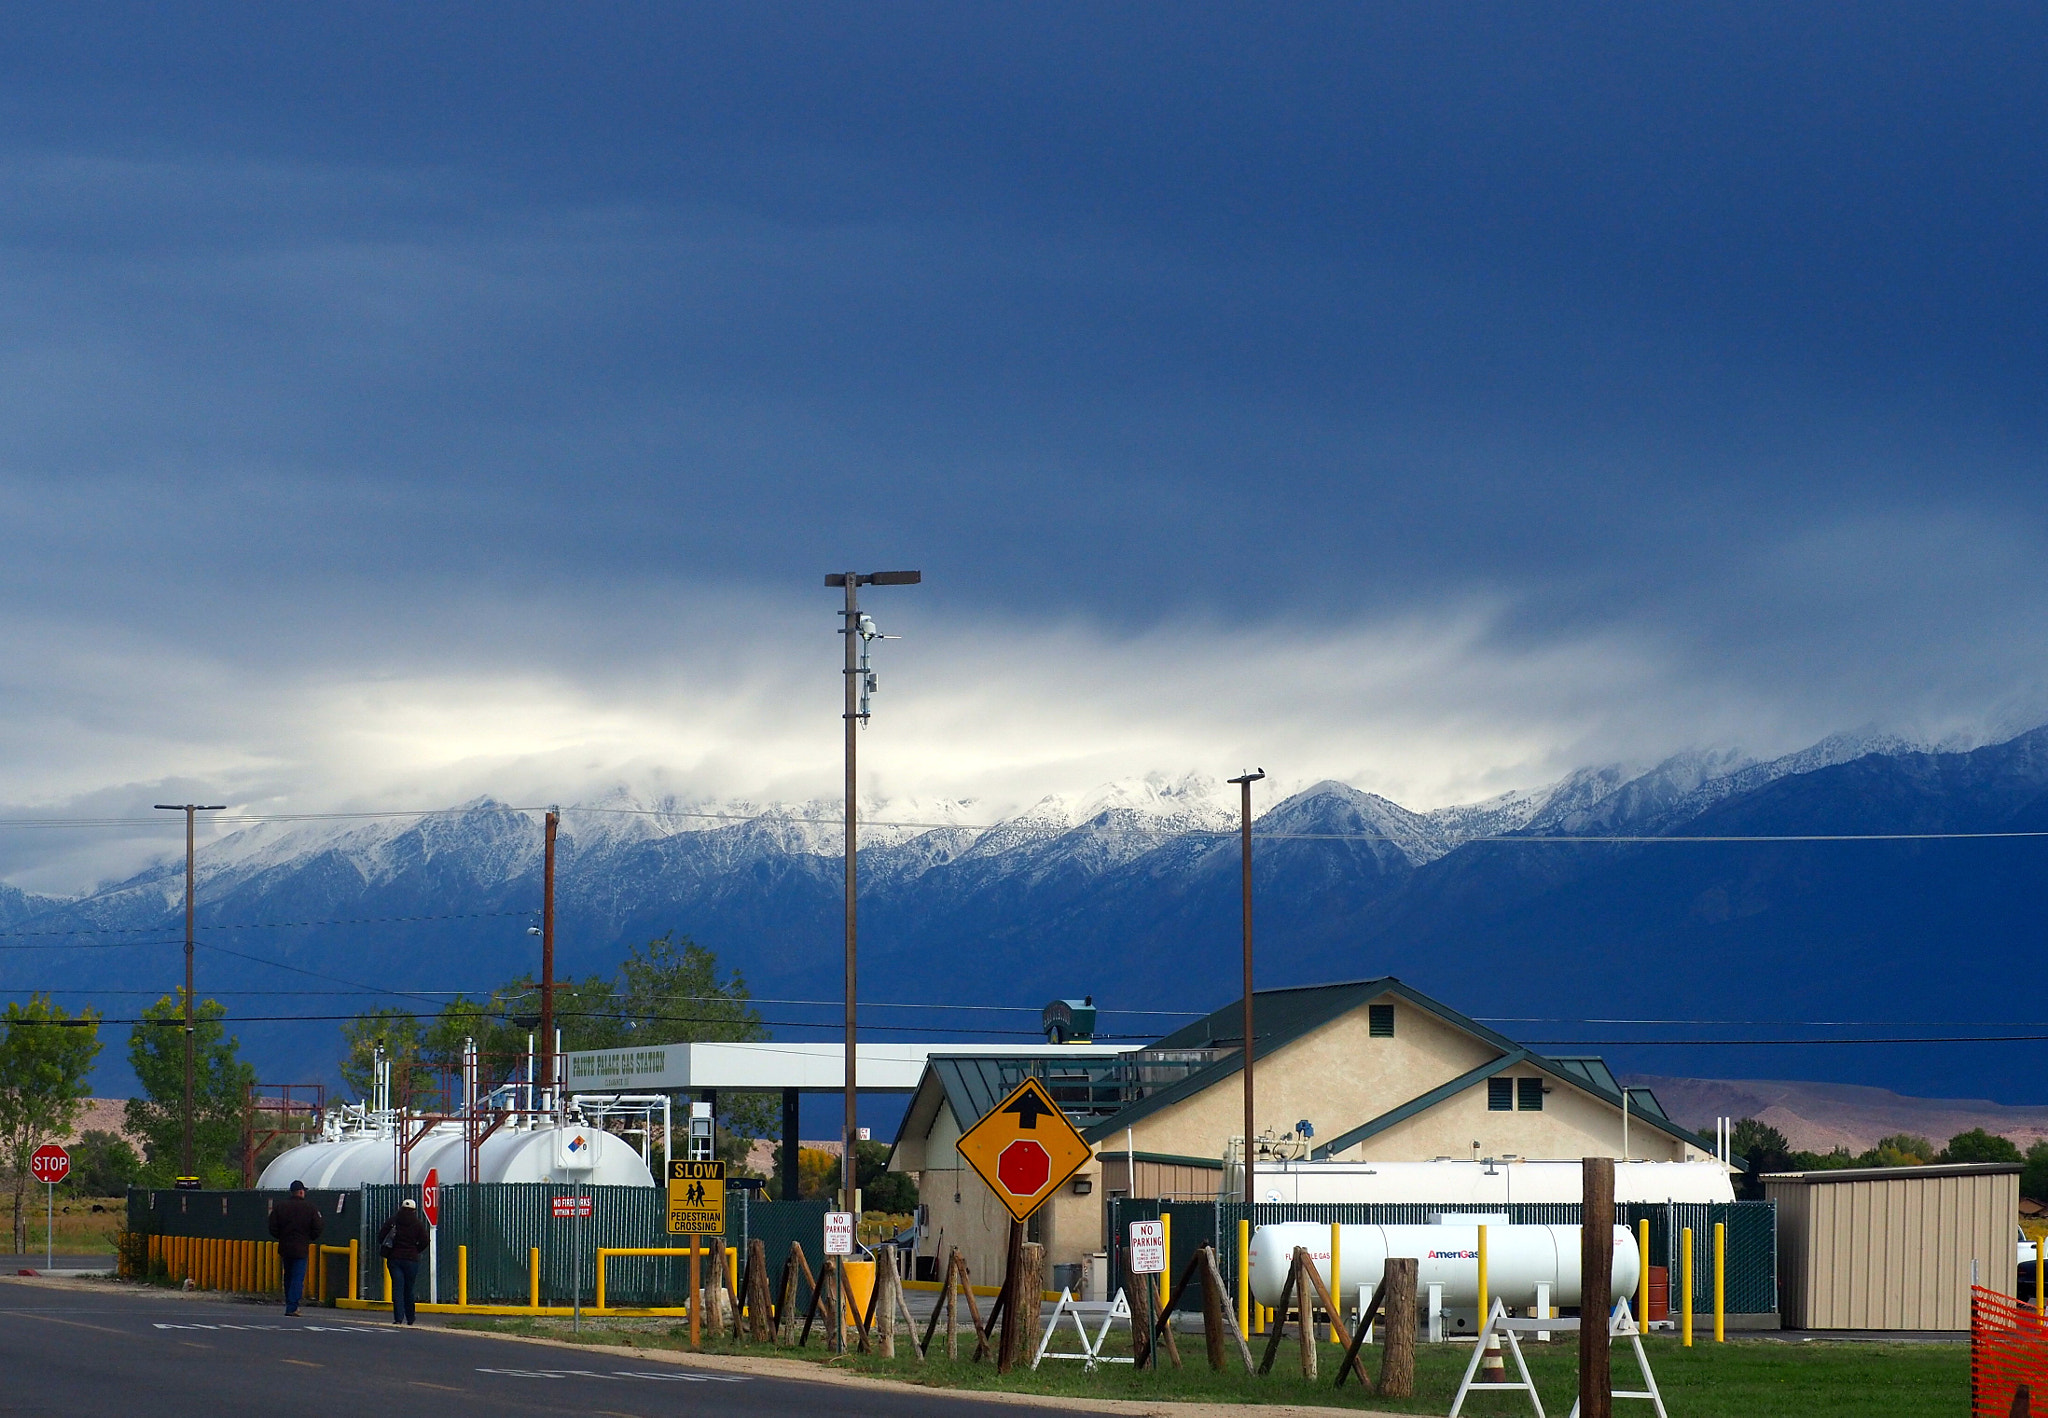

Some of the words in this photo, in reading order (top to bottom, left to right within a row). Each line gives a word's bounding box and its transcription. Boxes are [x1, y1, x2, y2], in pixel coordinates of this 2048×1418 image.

[597, 1054, 619, 1076] PALACE
[621, 1052, 634, 1075] GAS
[636, 1050, 665, 1074] STATION
[34, 1156, 67, 1171] STOP
[674, 1163, 718, 1178] SLOW
[425, 1187, 438, 1208] ST
[553, 1198, 561, 1207] NO
[562, 1198, 591, 1207] FIRERKS
[671, 1212, 720, 1221] PEDESTRIAN
[833, 1216, 843, 1224] NO
[674, 1221, 717, 1231] CROSSING
[826, 1225, 851, 1233] PARKING
[1140, 1225, 1153, 1236] NO
[1132, 1236, 1162, 1247] PARKING
[1318, 1252, 1331, 1260] GAS
[1428, 1250, 1479, 1259] AmeriGas
